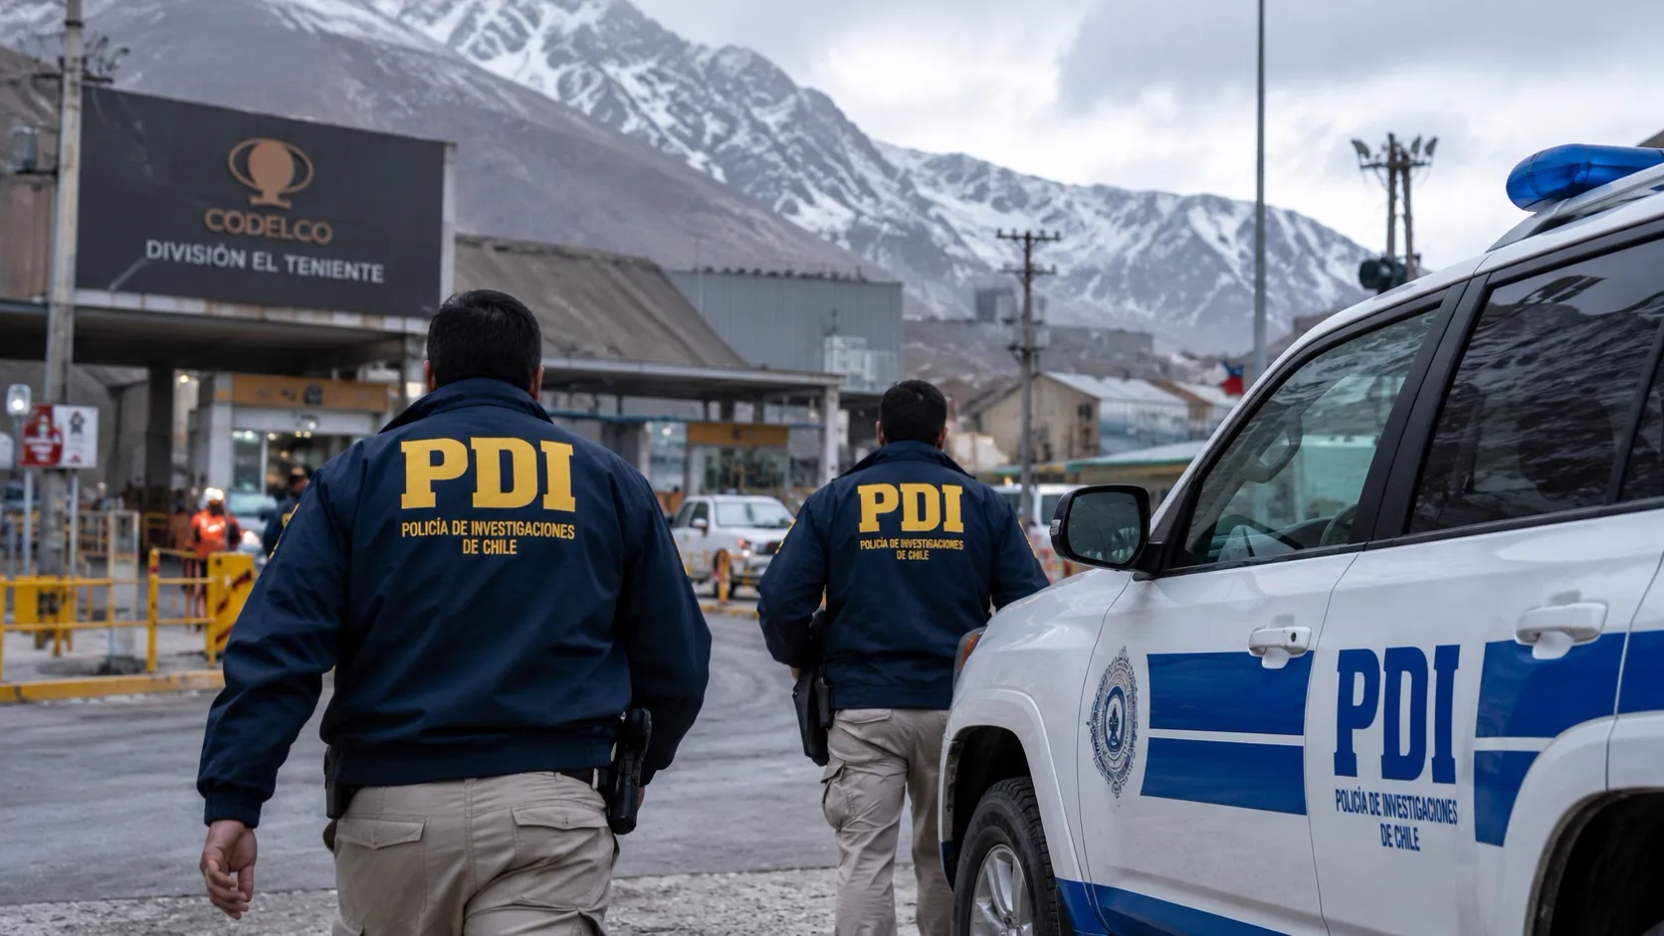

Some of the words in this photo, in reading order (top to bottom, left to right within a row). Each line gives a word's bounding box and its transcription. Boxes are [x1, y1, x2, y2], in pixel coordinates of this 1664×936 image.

[204, 208, 333, 245] CODELCO
[145, 239, 247, 269] DIVISIÓN
[252, 252, 279, 273] EL
[284, 254, 385, 284] TENIENTE
[401, 437, 576, 513] PDI
[857, 483, 964, 533] PDI
[401, 517, 449, 538] POLICÍA
[451, 520, 468, 536] DE
[471, 520, 575, 540] INVESTIGACIONES
[462, 539, 479, 555] DE
[482, 539, 517, 555] CHILE
[860, 537, 888, 550] POLICÍA
[889, 538, 900, 549] DE
[896, 550, 907, 560] DE
[908, 550, 930, 560] CHILE
[1333, 644, 1461, 785] PDI
[1335, 786, 1368, 816] POLICÍA
[1369, 791, 1382, 817] DE
[1382, 792, 1458, 826] INVESTIGACIONES
[1380, 823, 1393, 848] DE
[1394, 825, 1421, 851] CHILE
